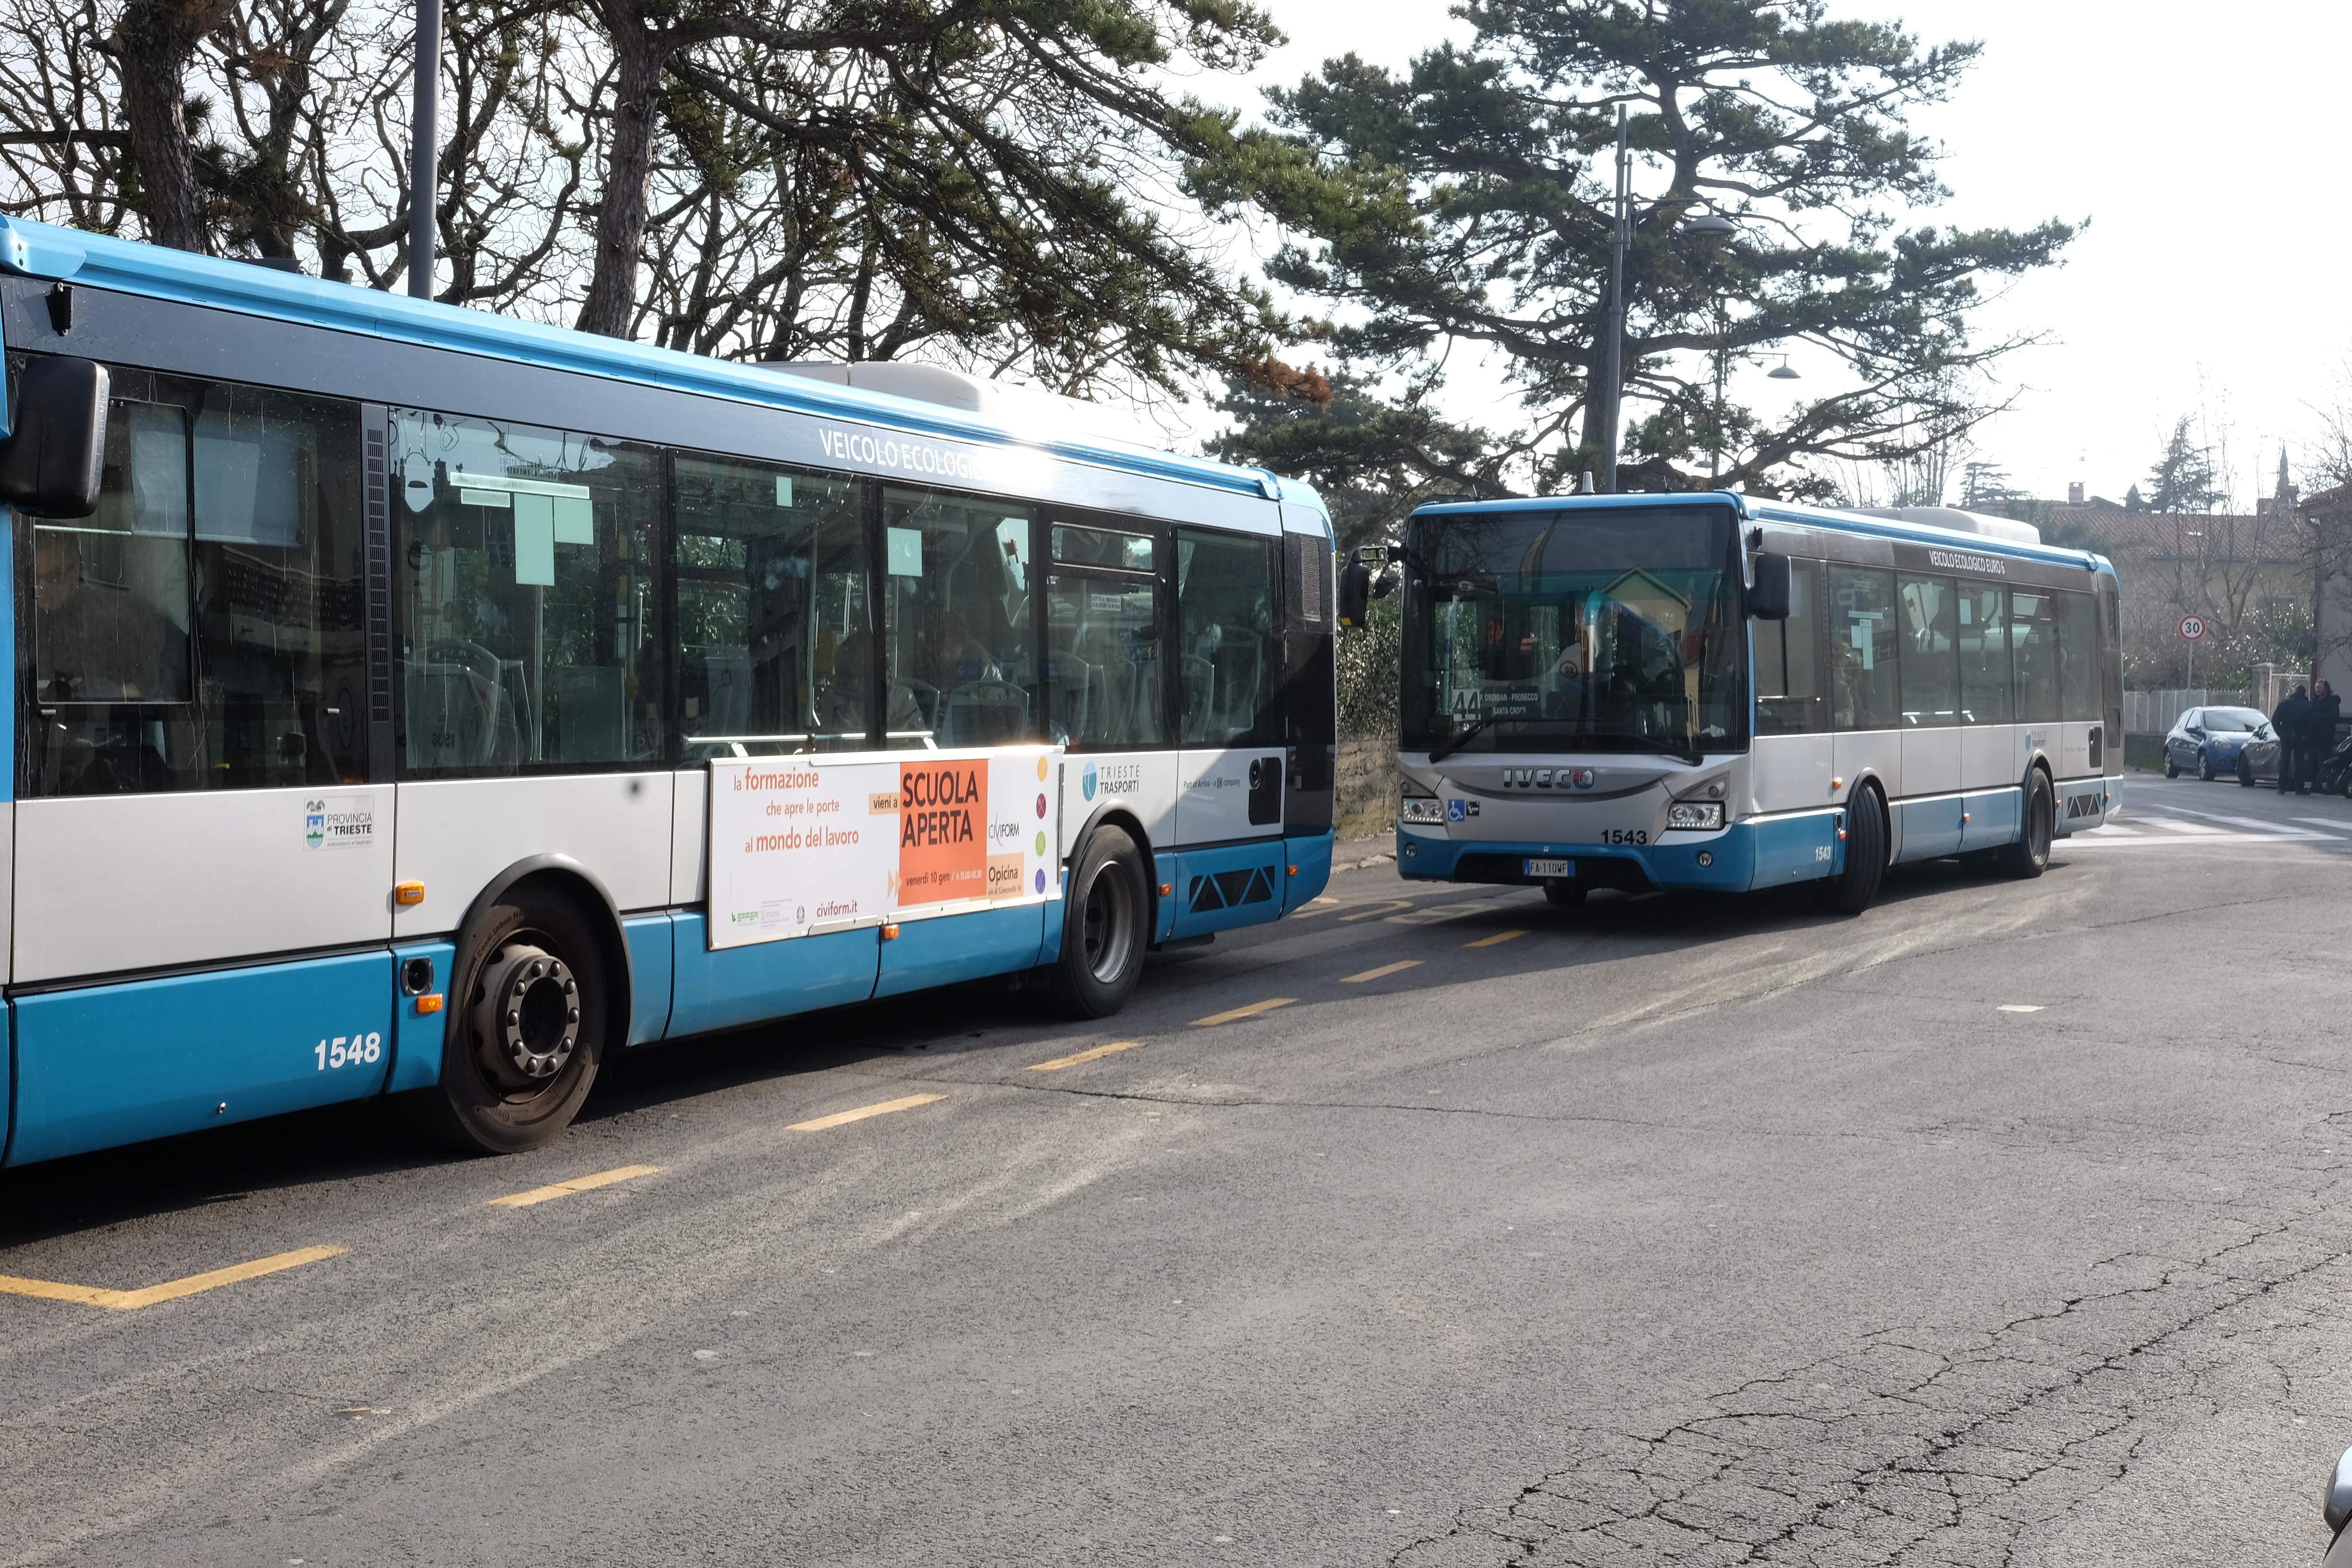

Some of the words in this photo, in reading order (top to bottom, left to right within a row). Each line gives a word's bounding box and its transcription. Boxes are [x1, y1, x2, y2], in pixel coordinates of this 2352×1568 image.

[819, 428, 898, 467] VEICOLO
[1929, 550, 1954, 567] VEICOLO
[1954, 553, 1985, 572] ECOLOGICO
[1985, 558, 2001, 574] EURO
[2001, 560, 2006, 575] 6
[2185, 622, 2200, 634] 30
[1454, 691, 1481, 719] 44
[1511, 693, 1538, 701] PROSECCO
[1493, 707, 1509, 715] SANTA
[734, 774, 741, 791] la
[745, 766, 819, 790] formazione
[1100, 764, 1139, 779] TRIESTE
[1504, 769, 1594, 789] IVECO
[903, 771, 979, 808] SCUOLA
[1100, 780, 1139, 795] TRASPORTI
[766, 799, 781, 816] che
[784, 803, 804, 819] apre
[807, 797, 814, 813] le
[817, 799, 840, 818] porte
[873, 795, 891, 809] vieni
[894, 800, 897, 808] a
[328, 812, 372, 825] PROVINCIA
[334, 824, 372, 835] TRIESTE
[901, 809, 973, 848] APERTA
[988, 816, 1019, 844] CIVIFORM
[1601, 829, 1647, 845] 1543
[745, 836, 753, 853] al
[756, 826, 801, 851] mondo
[806, 826, 821, 847] del
[826, 826, 859, 846] lavoro
[1815, 845, 1831, 861] 1543
[930, 871, 936, 882] 10
[939, 872, 950, 885] gen
[989, 864, 1018, 886] Opicina
[817, 899, 858, 918] civiform.it
[315, 1031, 380, 1071] 1548
